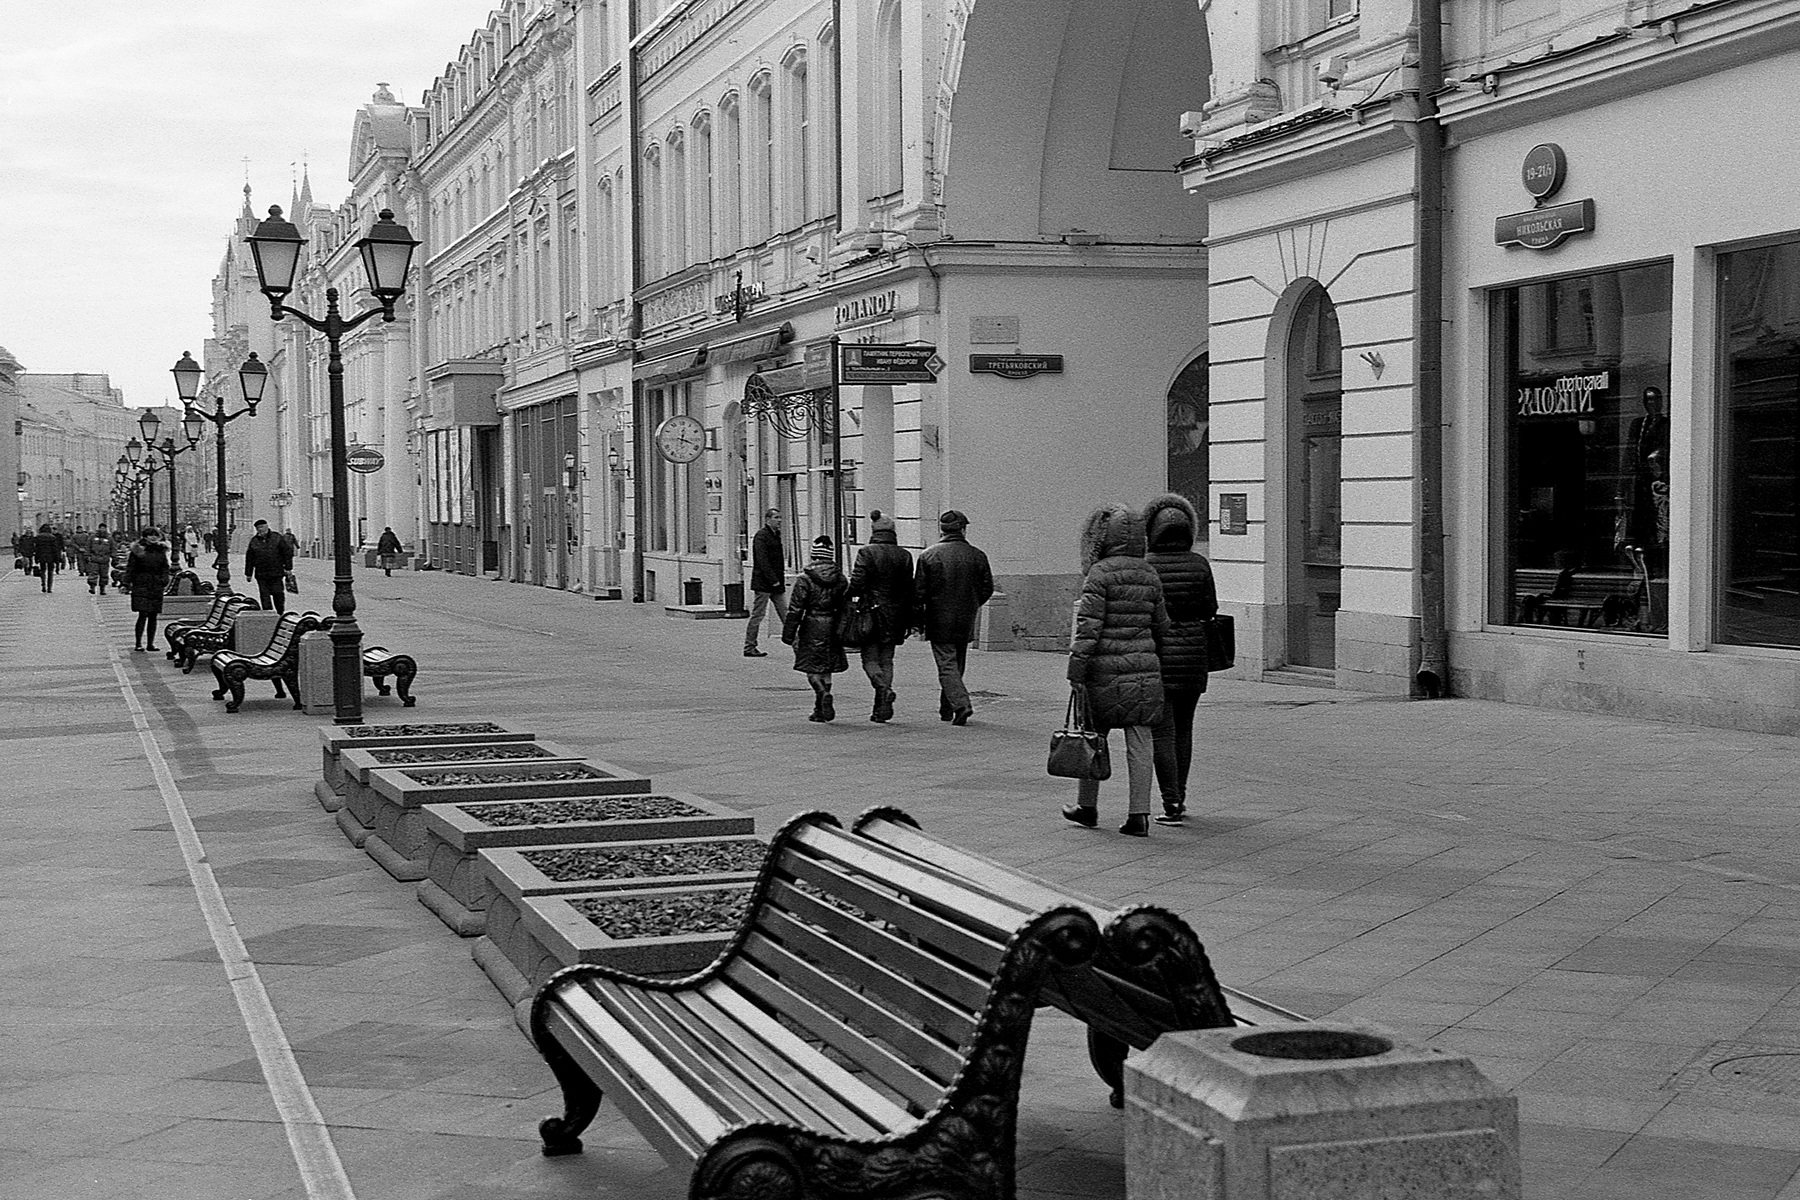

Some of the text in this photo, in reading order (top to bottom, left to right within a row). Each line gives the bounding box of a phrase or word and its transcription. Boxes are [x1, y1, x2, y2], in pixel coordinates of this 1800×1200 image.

[1516, 218, 1562, 236] НИКОЛЬСКАЯ
[834, 290, 896, 324] ROMANOV
[988, 361, 1048, 370] ТРЕТЬЯКОВСКИЙ
[346, 457, 384, 465] SUBWAY
